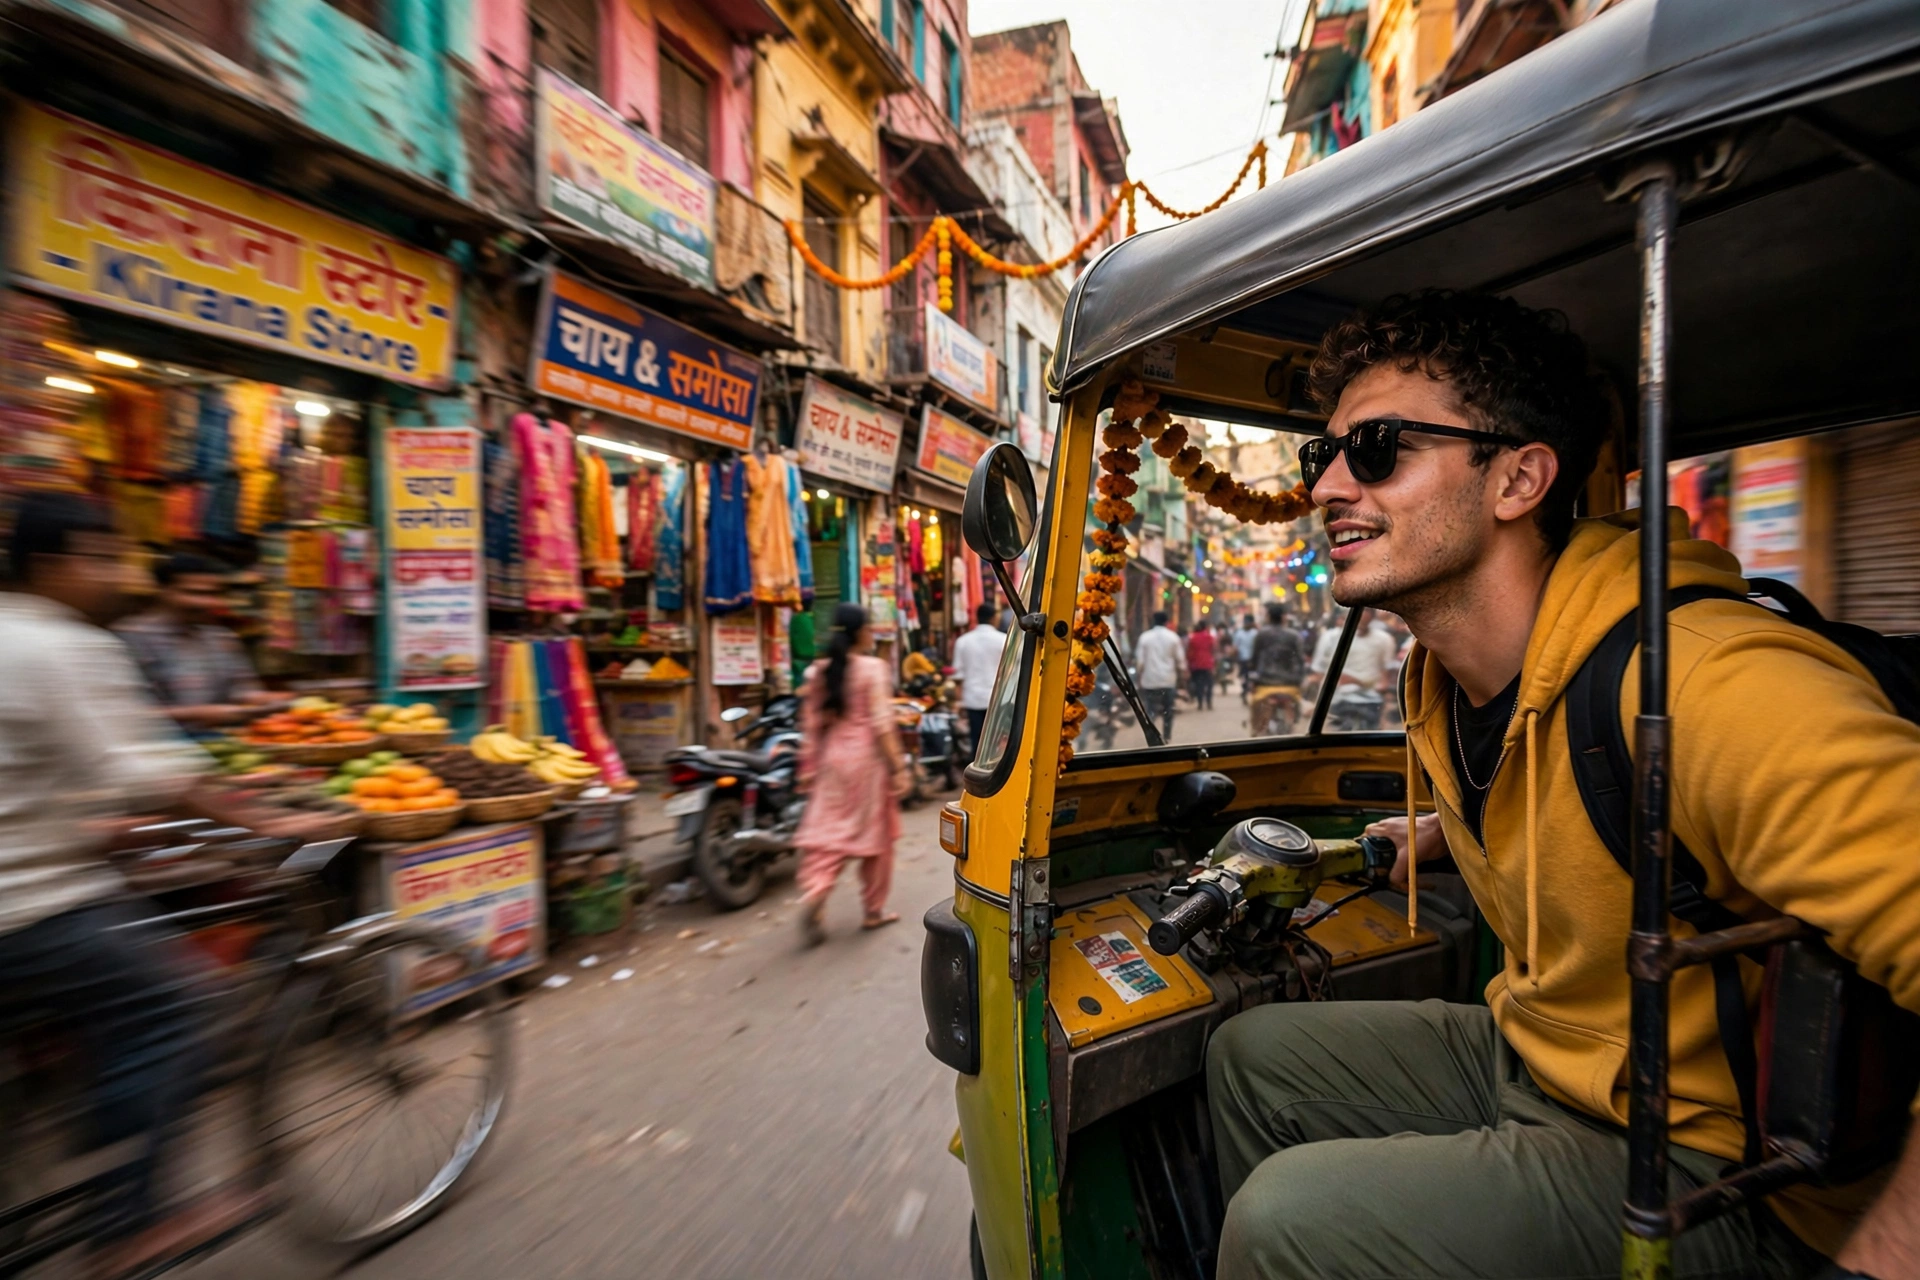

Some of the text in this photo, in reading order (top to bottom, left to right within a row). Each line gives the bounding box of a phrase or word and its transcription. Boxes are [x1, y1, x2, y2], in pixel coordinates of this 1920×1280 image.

[91, 241, 418, 373] Kirana Store
[318, 242, 428, 328] स्टोर
[557, 306, 633, 376] चाय
[634, 339, 661, 388] &
[667, 349, 753, 418] समोसा
[810, 402, 840, 435] चाय
